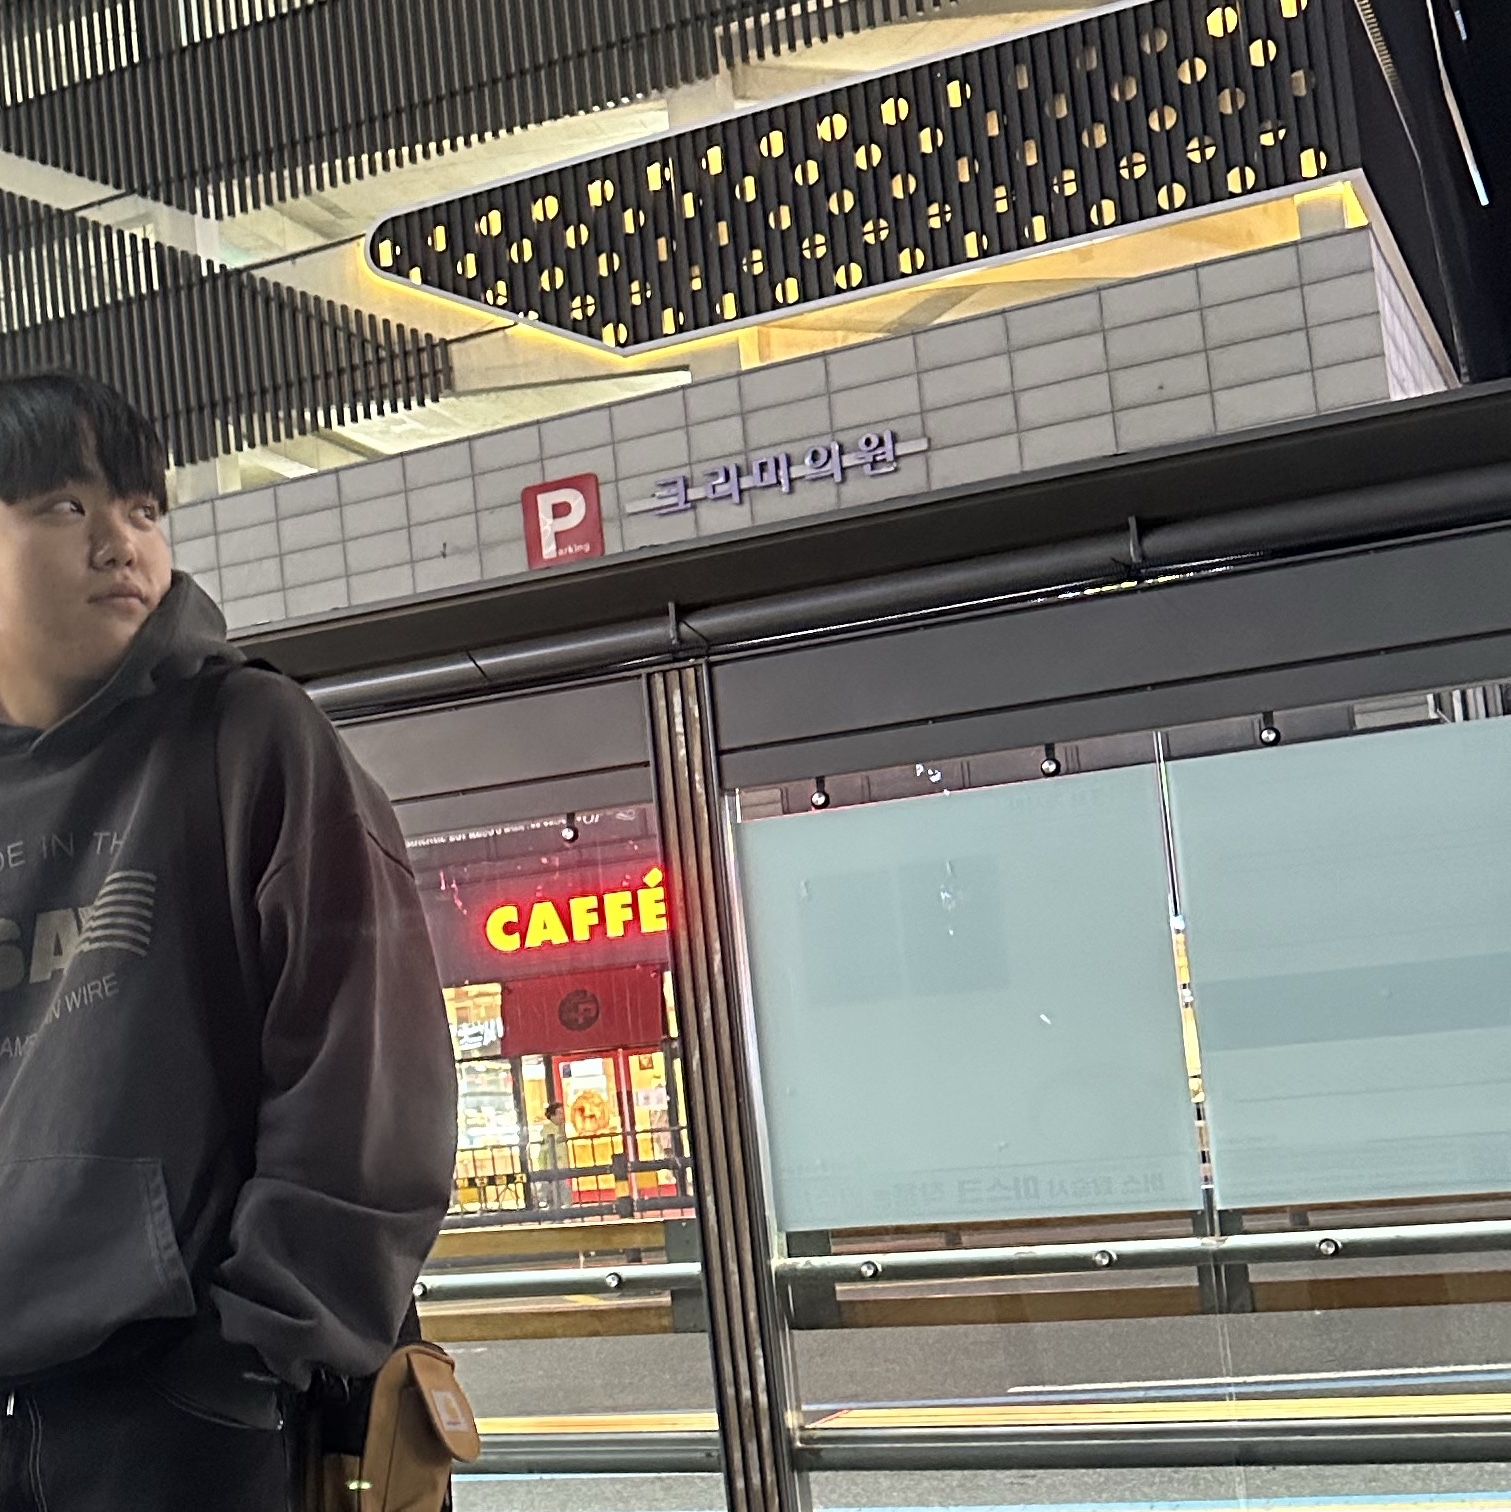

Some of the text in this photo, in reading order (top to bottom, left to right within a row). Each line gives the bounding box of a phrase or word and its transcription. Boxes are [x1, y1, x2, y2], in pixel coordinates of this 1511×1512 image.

[655, 429, 899, 516] 크리미의원
[41, 831, 75, 859] IN
[486, 866, 669, 952] CAFFÉ
[65, 972, 120, 1012] WIRE
